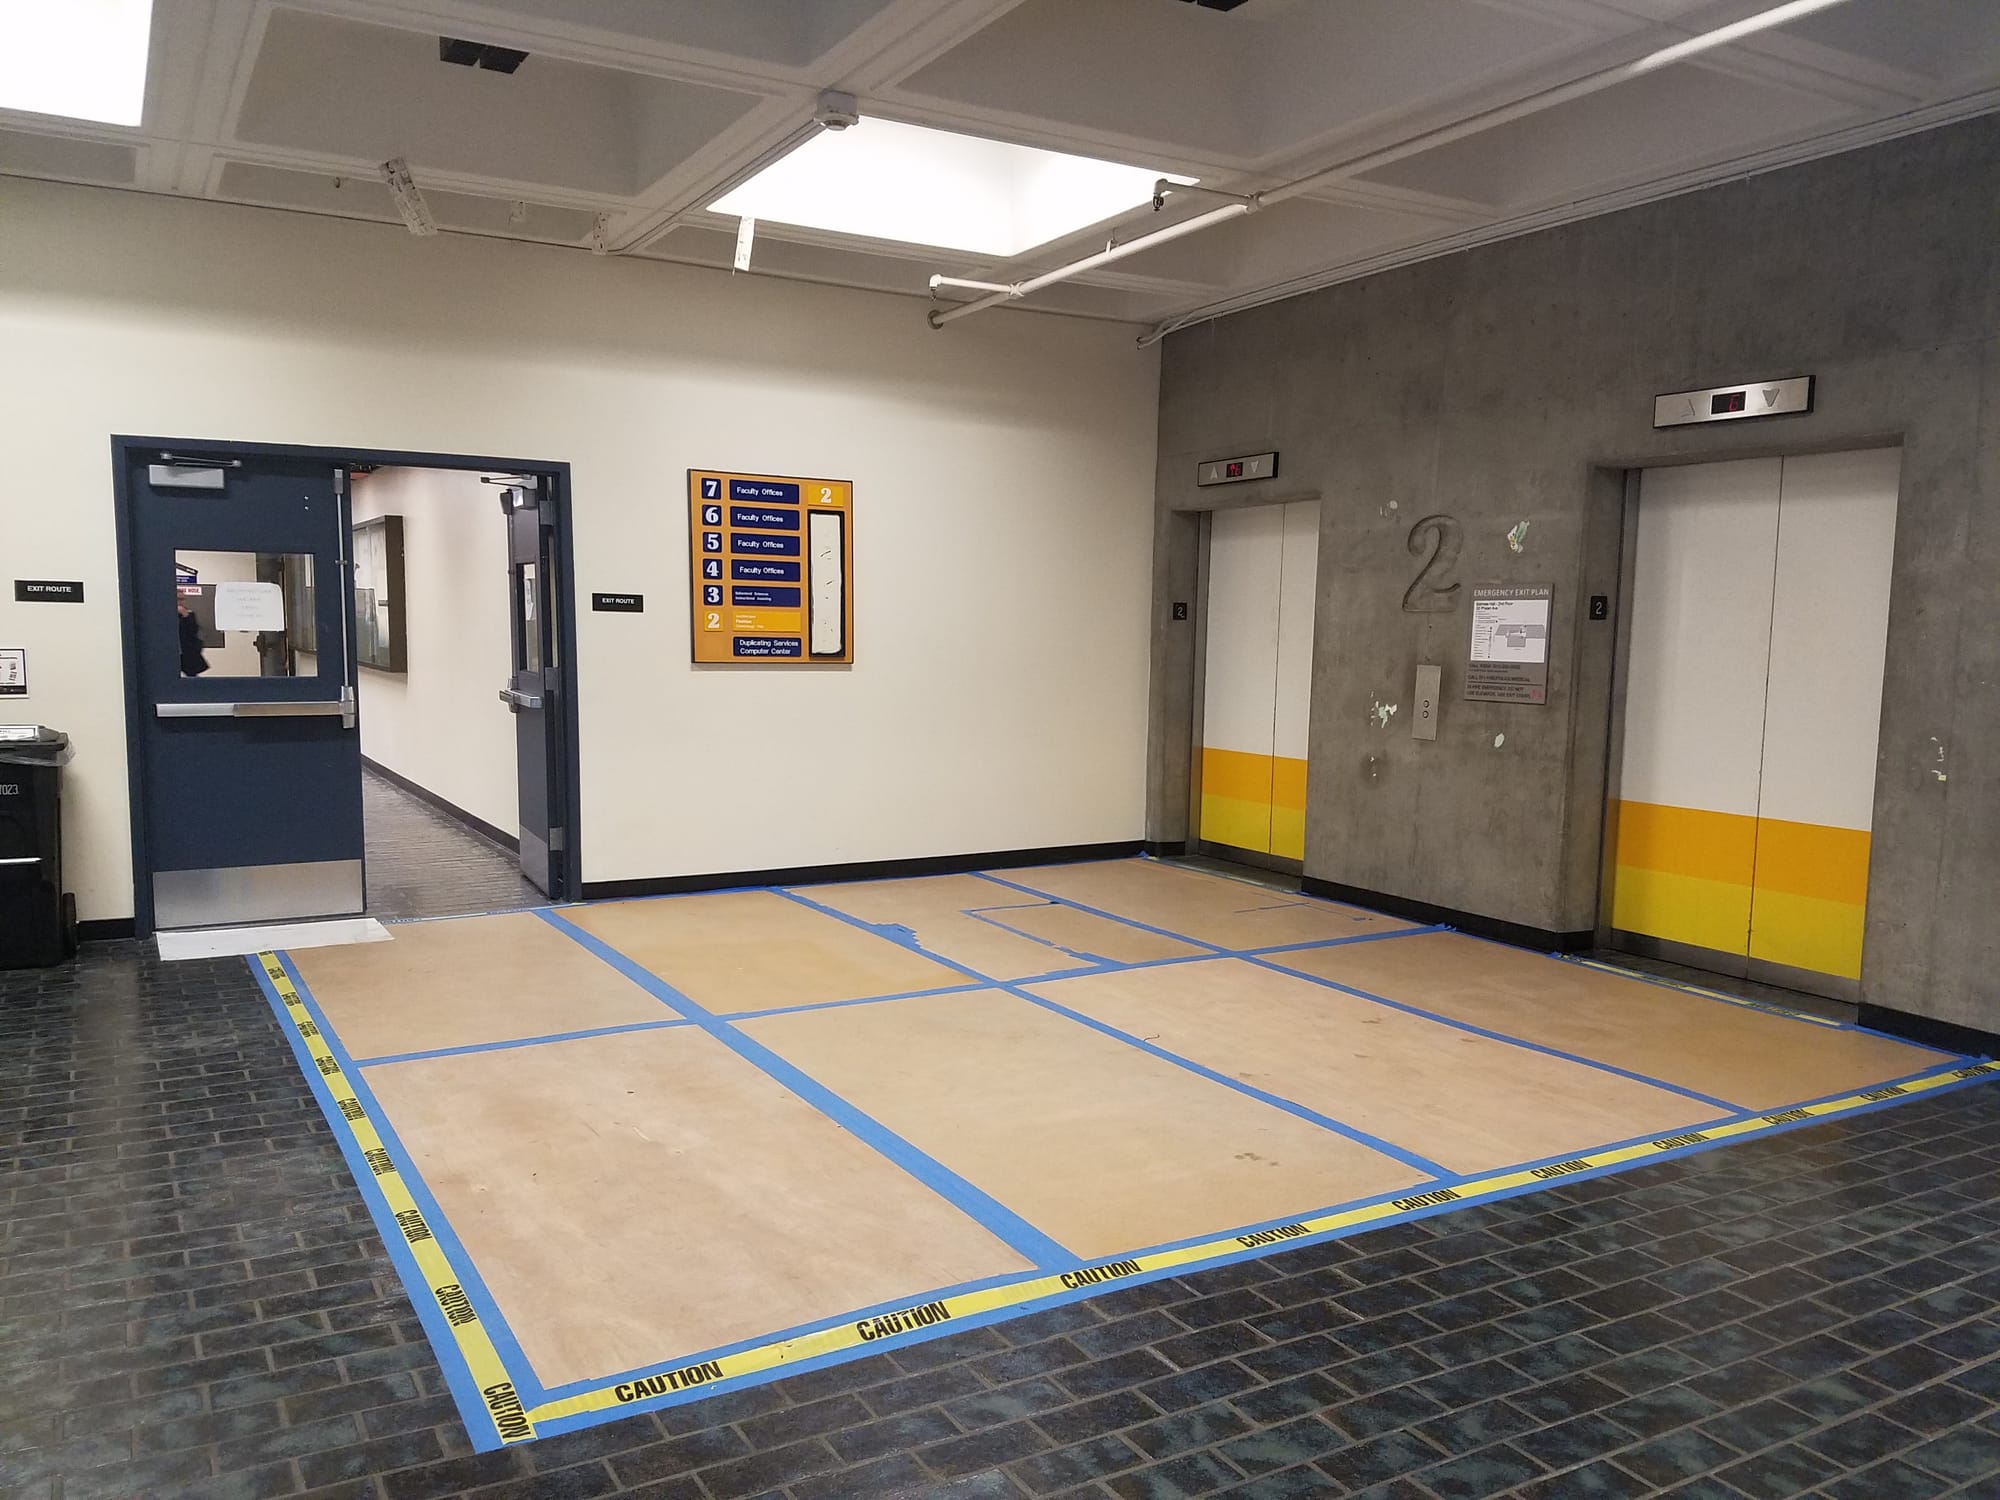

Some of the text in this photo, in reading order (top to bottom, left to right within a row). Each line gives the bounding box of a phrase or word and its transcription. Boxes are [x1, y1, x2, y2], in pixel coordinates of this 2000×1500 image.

[705, 481, 718, 497] 7
[736, 486, 784, 497] Faculty Offices
[820, 487, 832, 504] 2
[705, 507, 719, 524] 6
[737, 513, 784, 523] Faculty Offices
[707, 533, 719, 550] 5
[738, 539, 784, 549] Faculty Offices
[706, 560, 719, 577] 4
[739, 566, 785, 576] Faculty Offices
[1402, 514, 1464, 613] 2
[45, 585, 72, 593] ROUTE
[707, 586, 720, 603] 3
[1474, 588, 1549, 597] EMERGENCY EXIT PLAN
[1177, 606, 1185, 618] 2
[1595, 601, 1603, 615] 2
[707, 612, 720, 629] 2
[739, 639, 799, 648] Duplicating Services
[739, 647, 791, 656] Computer Center
[1761, 1108, 1814, 1124] CAUTION
[1652, 1132, 1709, 1150] CAUTION
[364, 1147, 397, 1176] CAUTION
[1530, 1159, 1593, 1179] CAUTION
[1392, 1189, 1462, 1211] CAUTION
[395, 1209, 433, 1243] CAUTION
[1236, 1223, 1312, 1248] CAUTION
[1060, 1259, 1142, 1289] CAUTION
[435, 1284, 478, 1327] CAUTION
[857, 1301, 951, 1341] CAUTION
[615, 1361, 724, 1402] CAUTION
[483, 1382, 531, 1439] CAUTION
